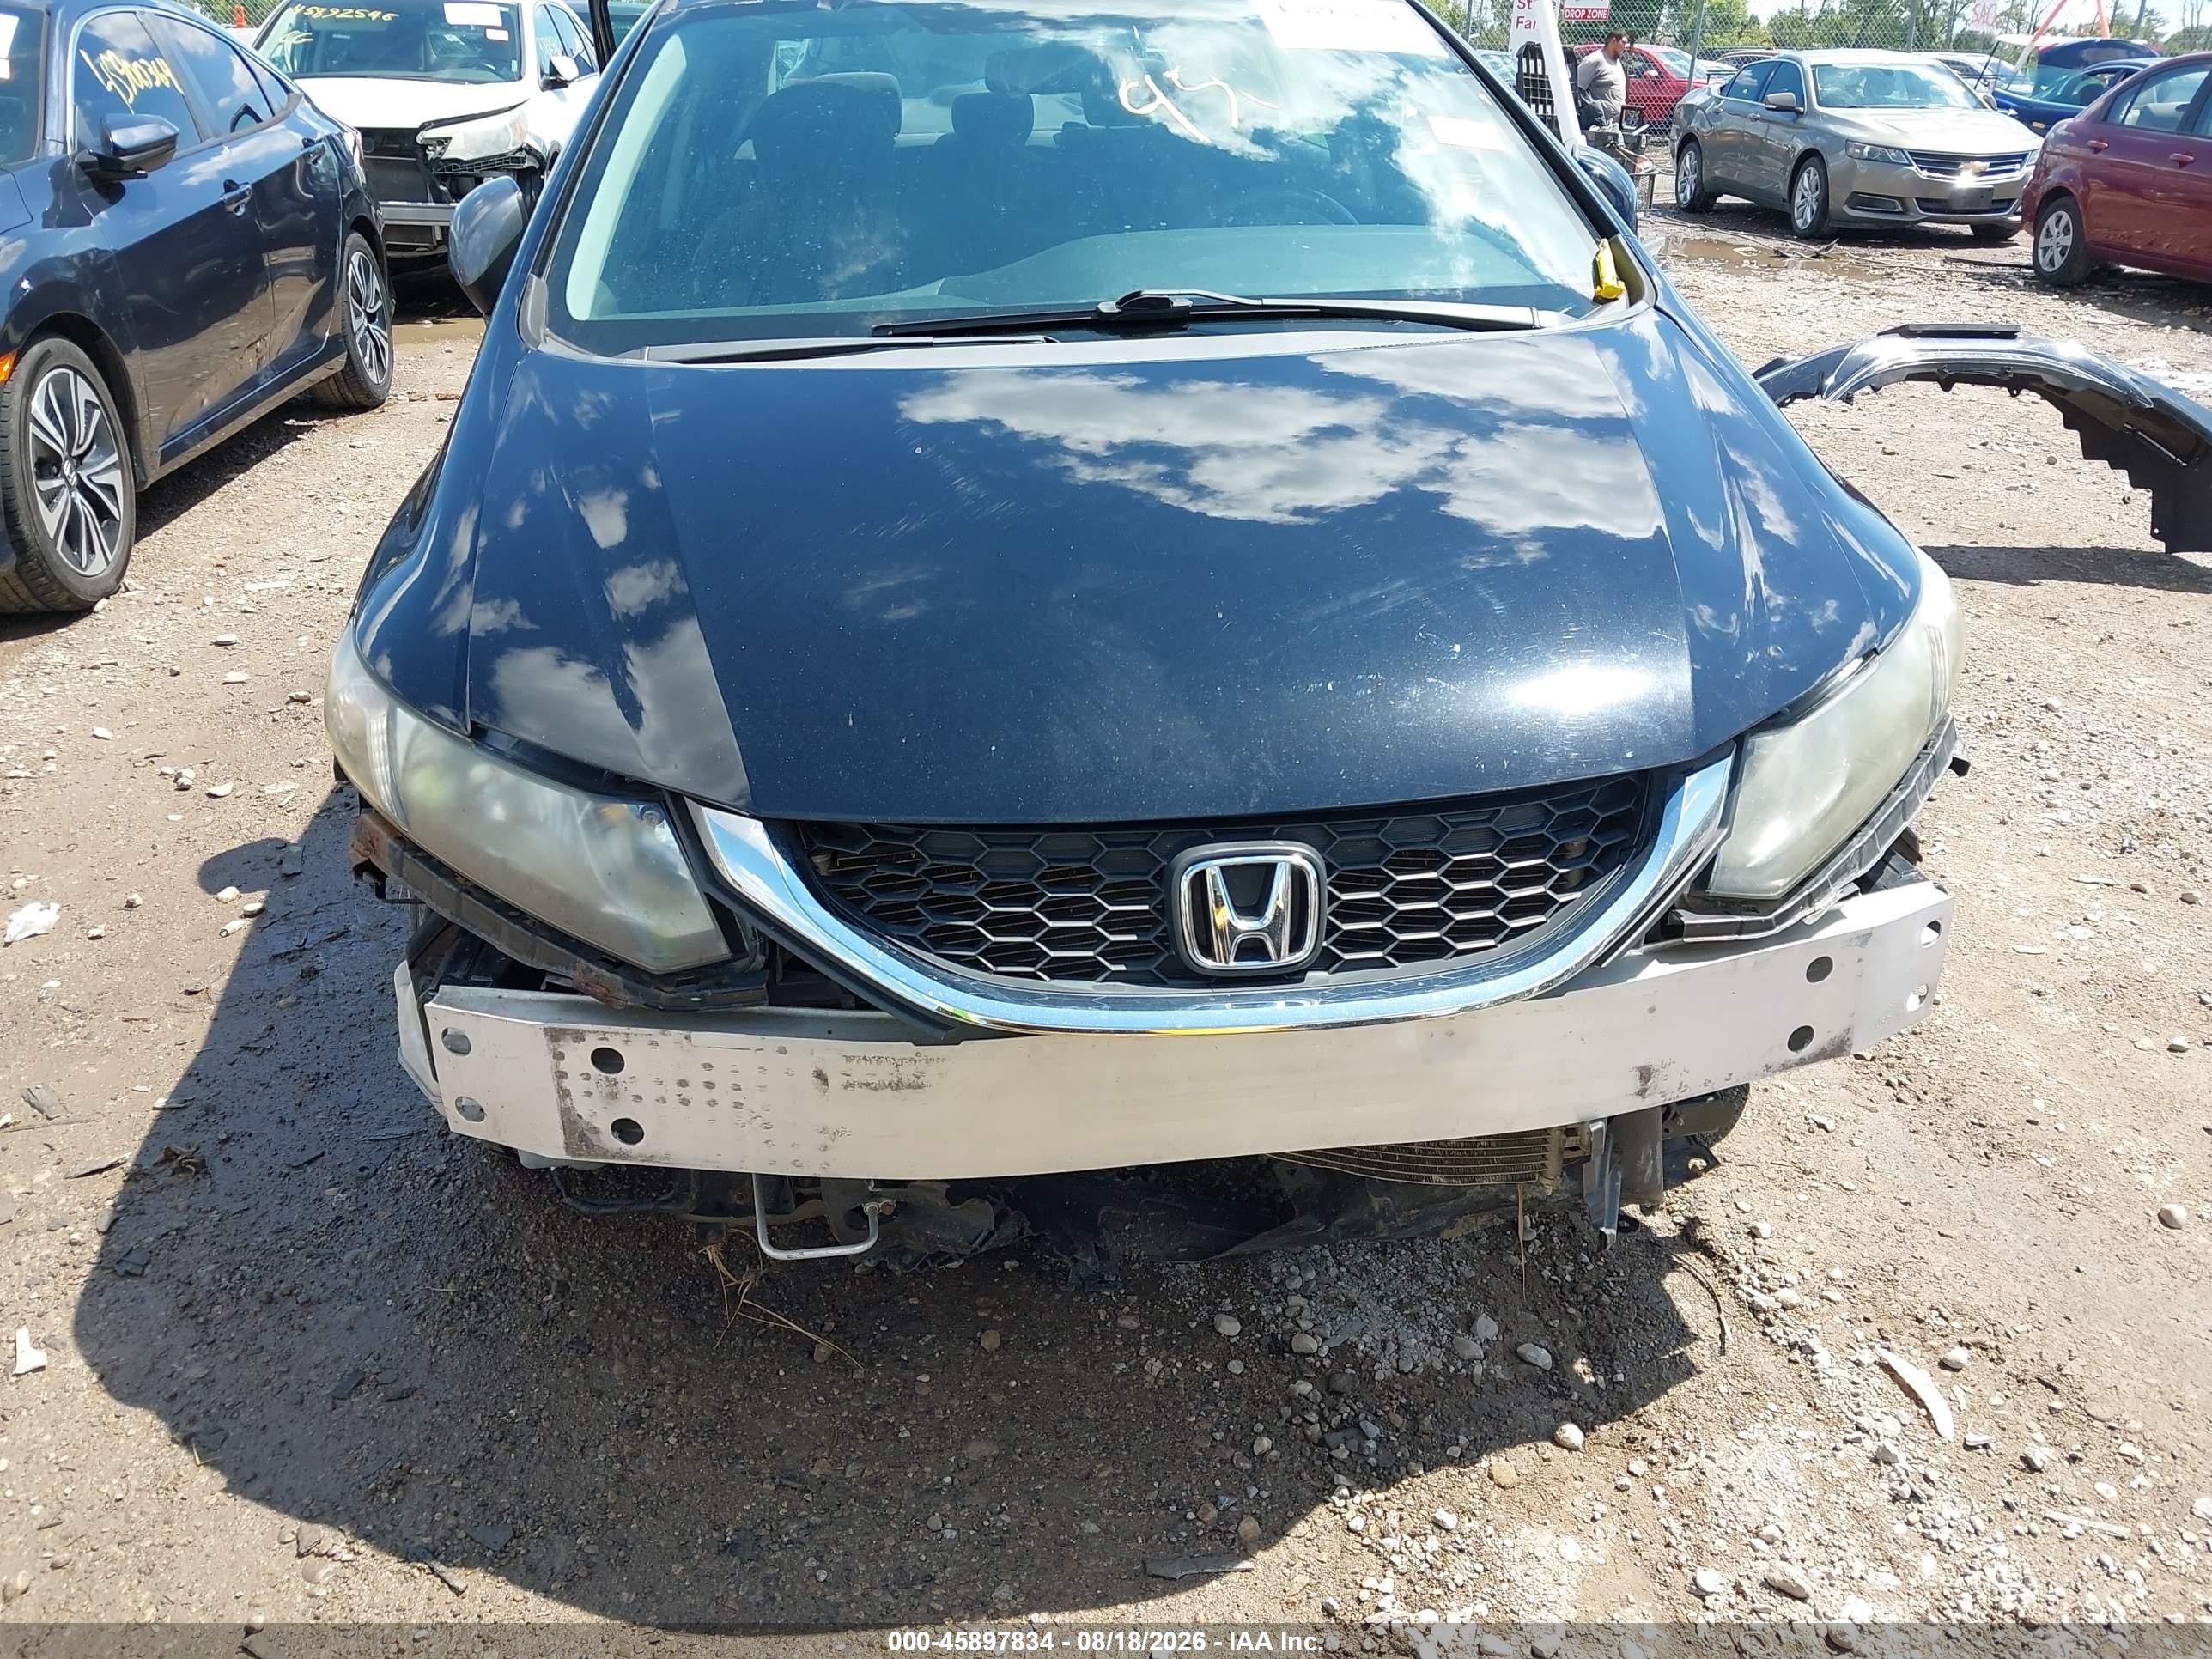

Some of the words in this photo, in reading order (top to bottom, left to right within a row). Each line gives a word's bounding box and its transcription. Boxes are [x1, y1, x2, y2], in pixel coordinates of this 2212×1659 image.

[293, 3, 399, 21] 45892546
[1564, 9, 1586, 19] DROP
[1586, 9, 1608, 19] ZONE
